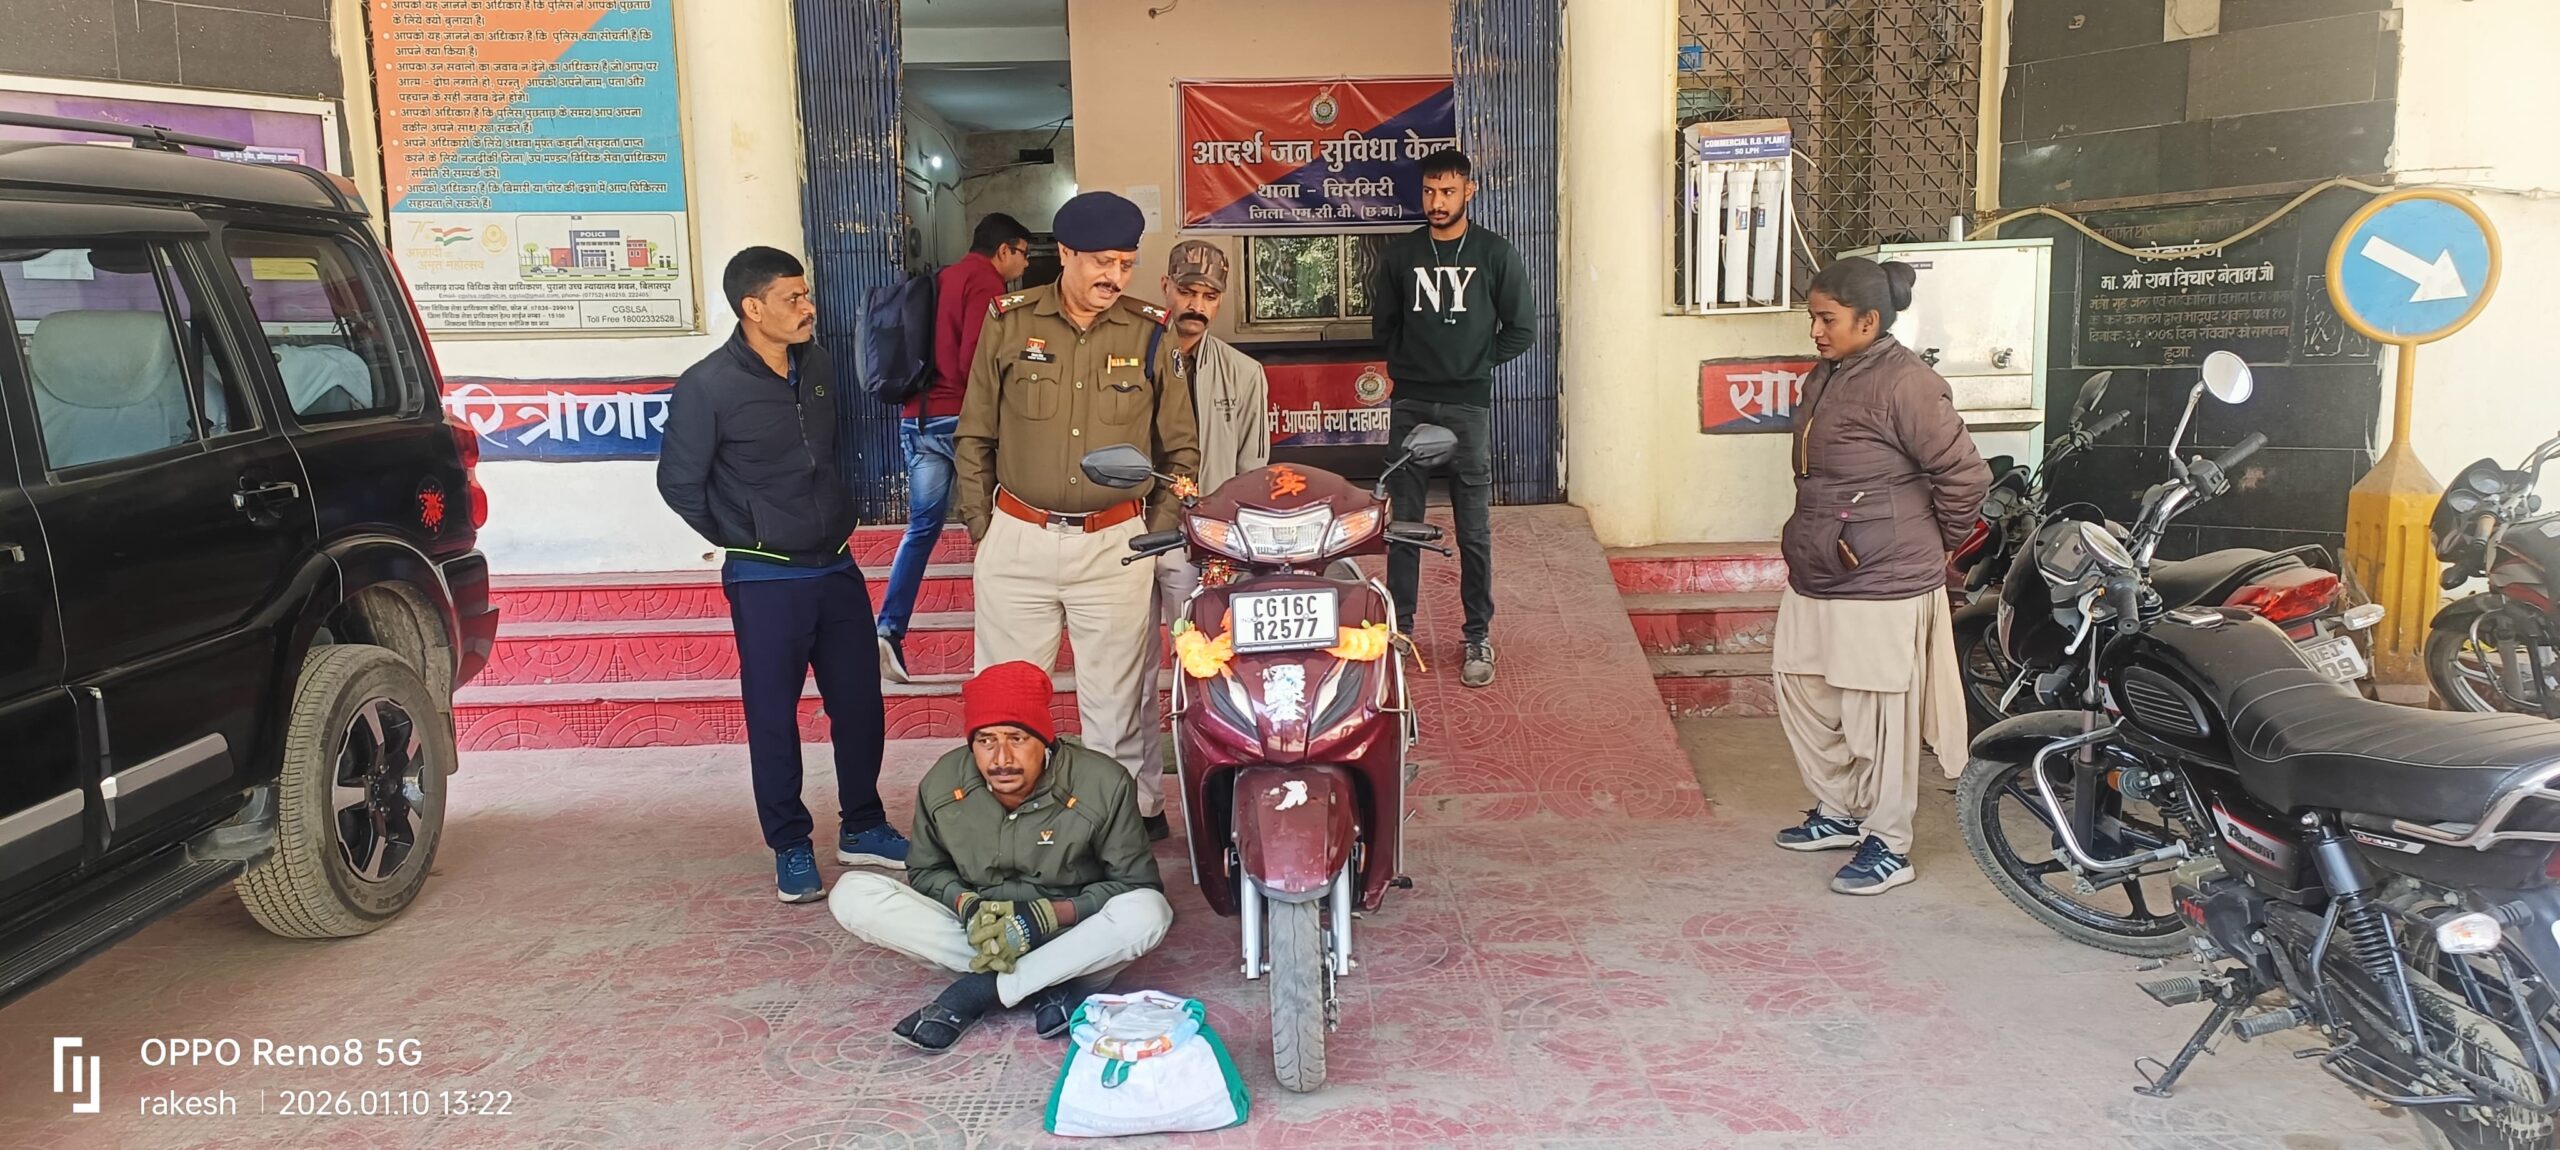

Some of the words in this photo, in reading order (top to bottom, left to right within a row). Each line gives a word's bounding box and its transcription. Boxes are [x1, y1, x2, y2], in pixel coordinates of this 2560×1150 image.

[1192, 130, 1264, 166] आदर्श
[1270, 138, 1313, 164] जन
[1320, 130, 1397, 172] सुविधा
[1704, 138, 1749, 148] COMMERCIAL
[1764, 136, 1786, 144] PLANT
[1258, 182, 1300, 199] थाना
[1323, 176, 1395, 198] चिरमिरी
[1413, 266, 1476, 313] NY
[2122, 268, 2143, 290] श्री
[2145, 272, 2173, 289] राम
[602, 315, 620, 323] Free
[441, 384, 673, 448] रित्राणा
[1323, 409, 1347, 432] क्या
[1348, 407, 1391, 432] सहायत
[1253, 595, 1317, 618] CG16C
[1254, 617, 1318, 641] R2577
